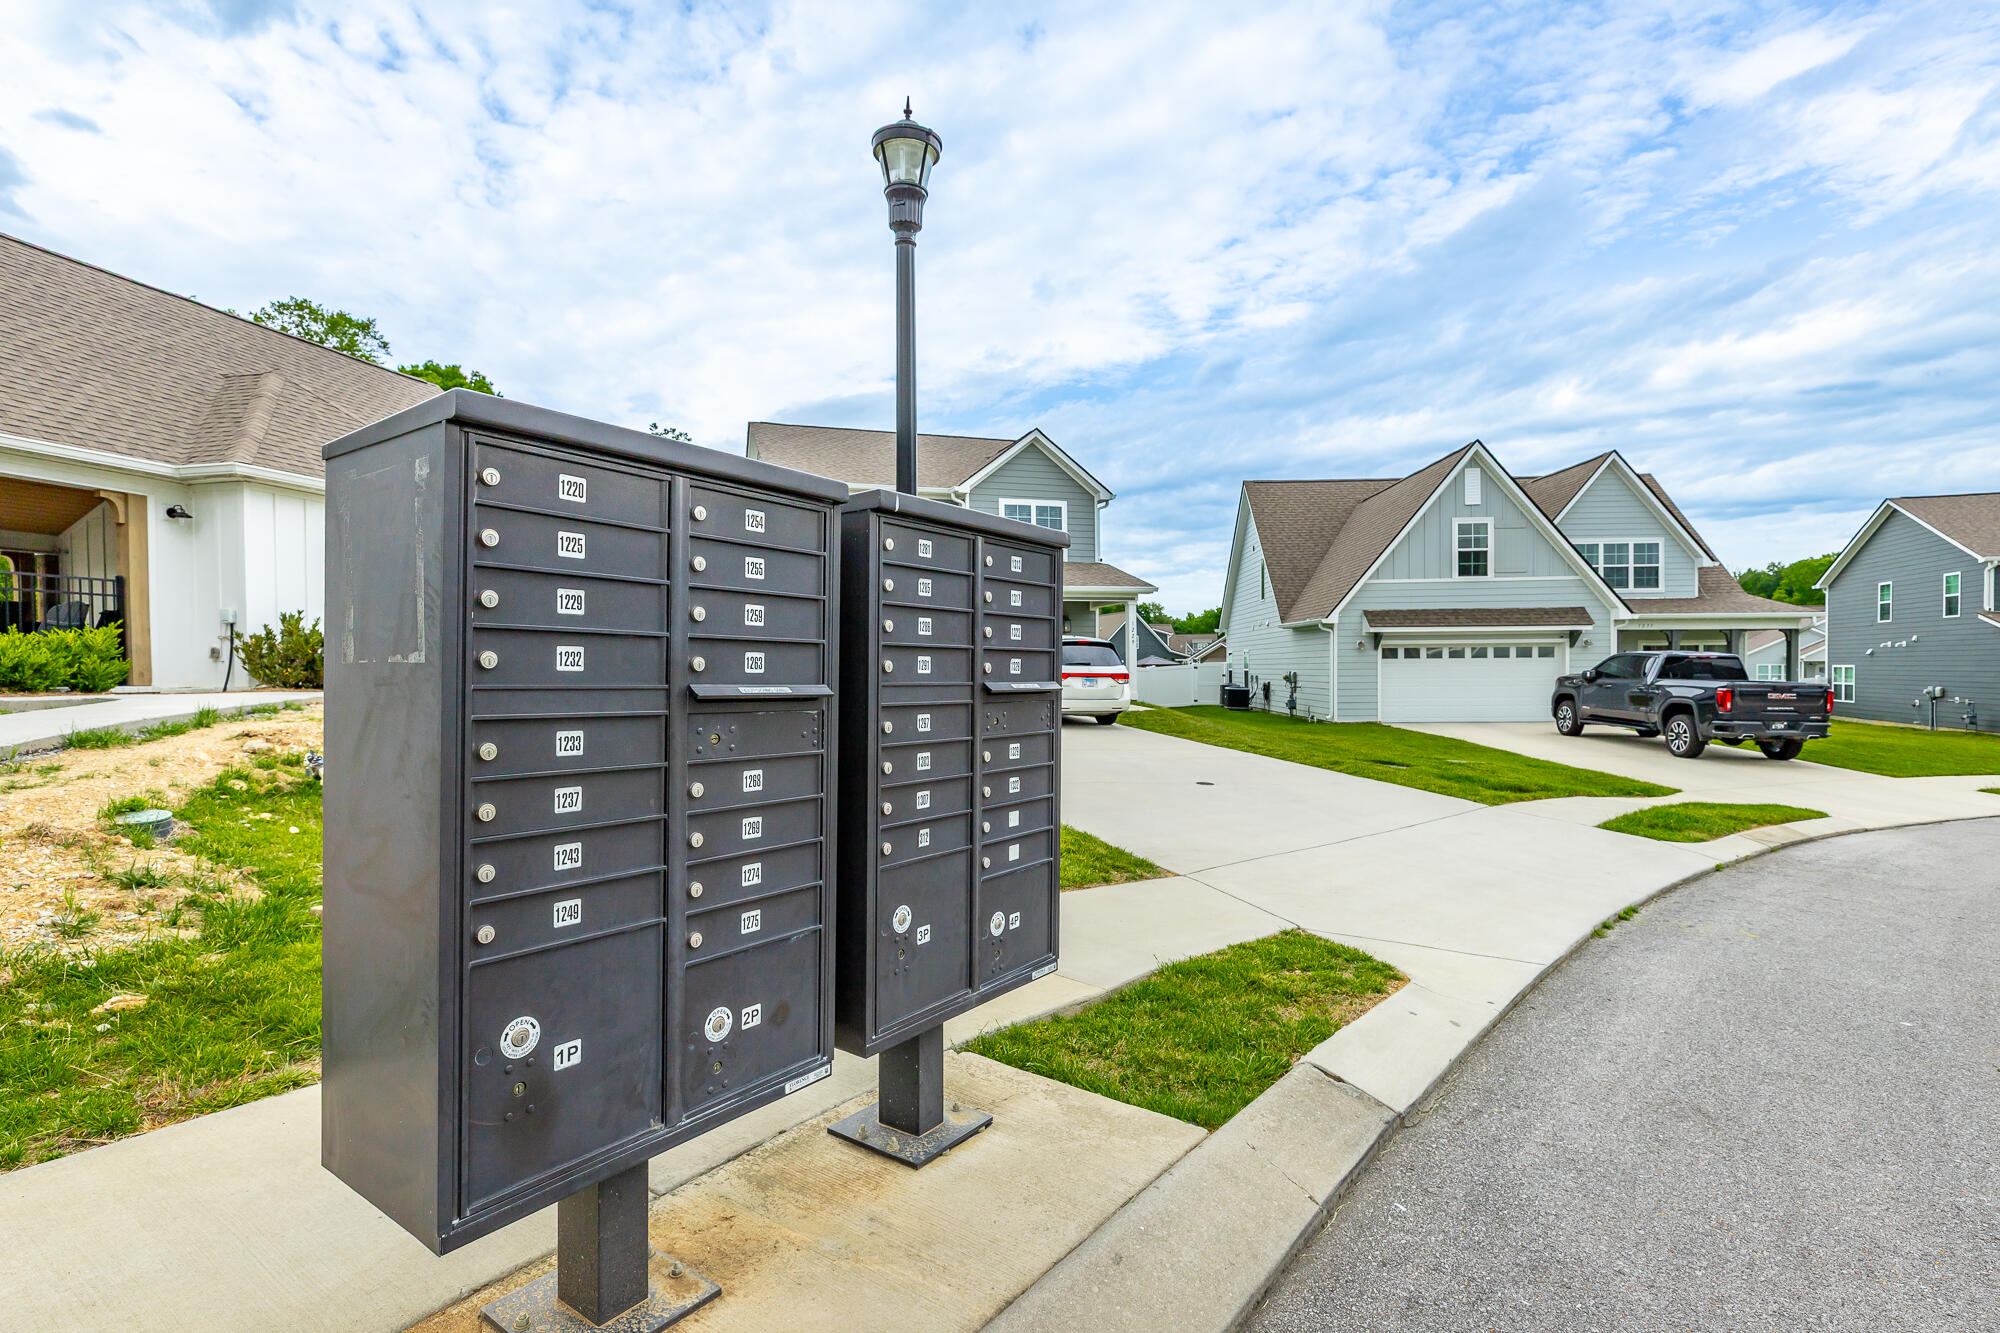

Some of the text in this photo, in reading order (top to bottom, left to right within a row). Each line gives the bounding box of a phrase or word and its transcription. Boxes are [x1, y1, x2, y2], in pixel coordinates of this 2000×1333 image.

[561, 479, 584, 499] 1220
[747, 514, 764, 530] 1254
[559, 535, 583, 554] 1225
[746, 561, 763, 576] 1255
[559, 593, 583, 611] 1229
[746, 608, 763, 623] 1259
[558, 650, 582, 667] 1232
[746, 656, 763, 670] 1263
[918, 717, 929, 729] 1297
[558, 735, 581, 752] 1233
[744, 773, 761, 789] 1268
[556, 791, 580, 809] 1237
[744, 820, 760, 836] 1269
[556, 847, 580, 866] 1243
[743, 867, 760, 883] 1274
[555, 903, 579, 923] 1249
[742, 913, 759, 931] 1275
[918, 928, 929, 942] 3P
[509, 1019, 531, 1032] OPEN
[743, 1008, 759, 1026] 2P
[556, 1045, 579, 1065] 1P
